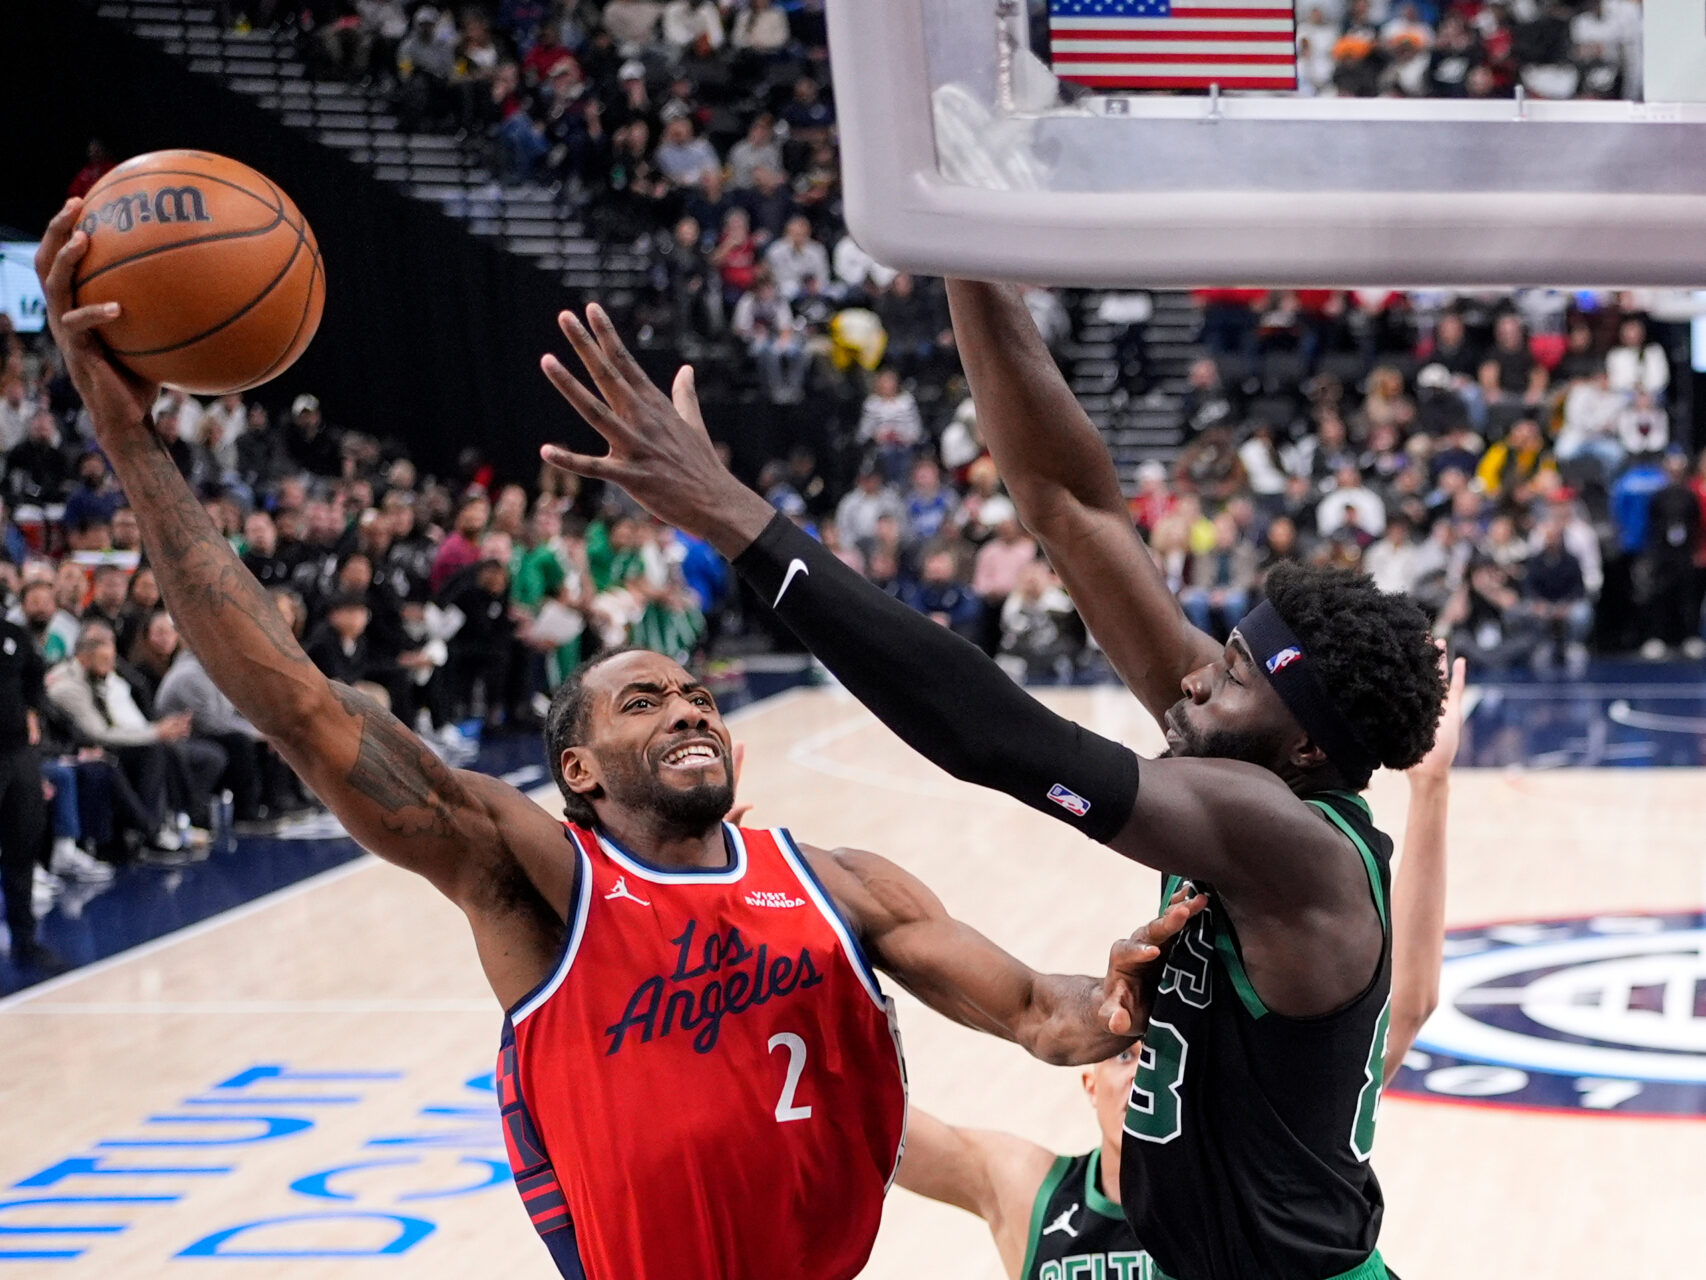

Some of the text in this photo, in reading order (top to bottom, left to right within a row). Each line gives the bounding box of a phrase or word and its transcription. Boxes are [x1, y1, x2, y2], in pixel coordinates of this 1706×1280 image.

[76, 185, 213, 235] Wilso
[744, 896, 806, 908] RWANDA
[751, 891, 787, 900] VISIT
[669, 919, 753, 982] Los
[604, 944, 823, 1057] Angeles
[768, 1032, 812, 1122] 2
